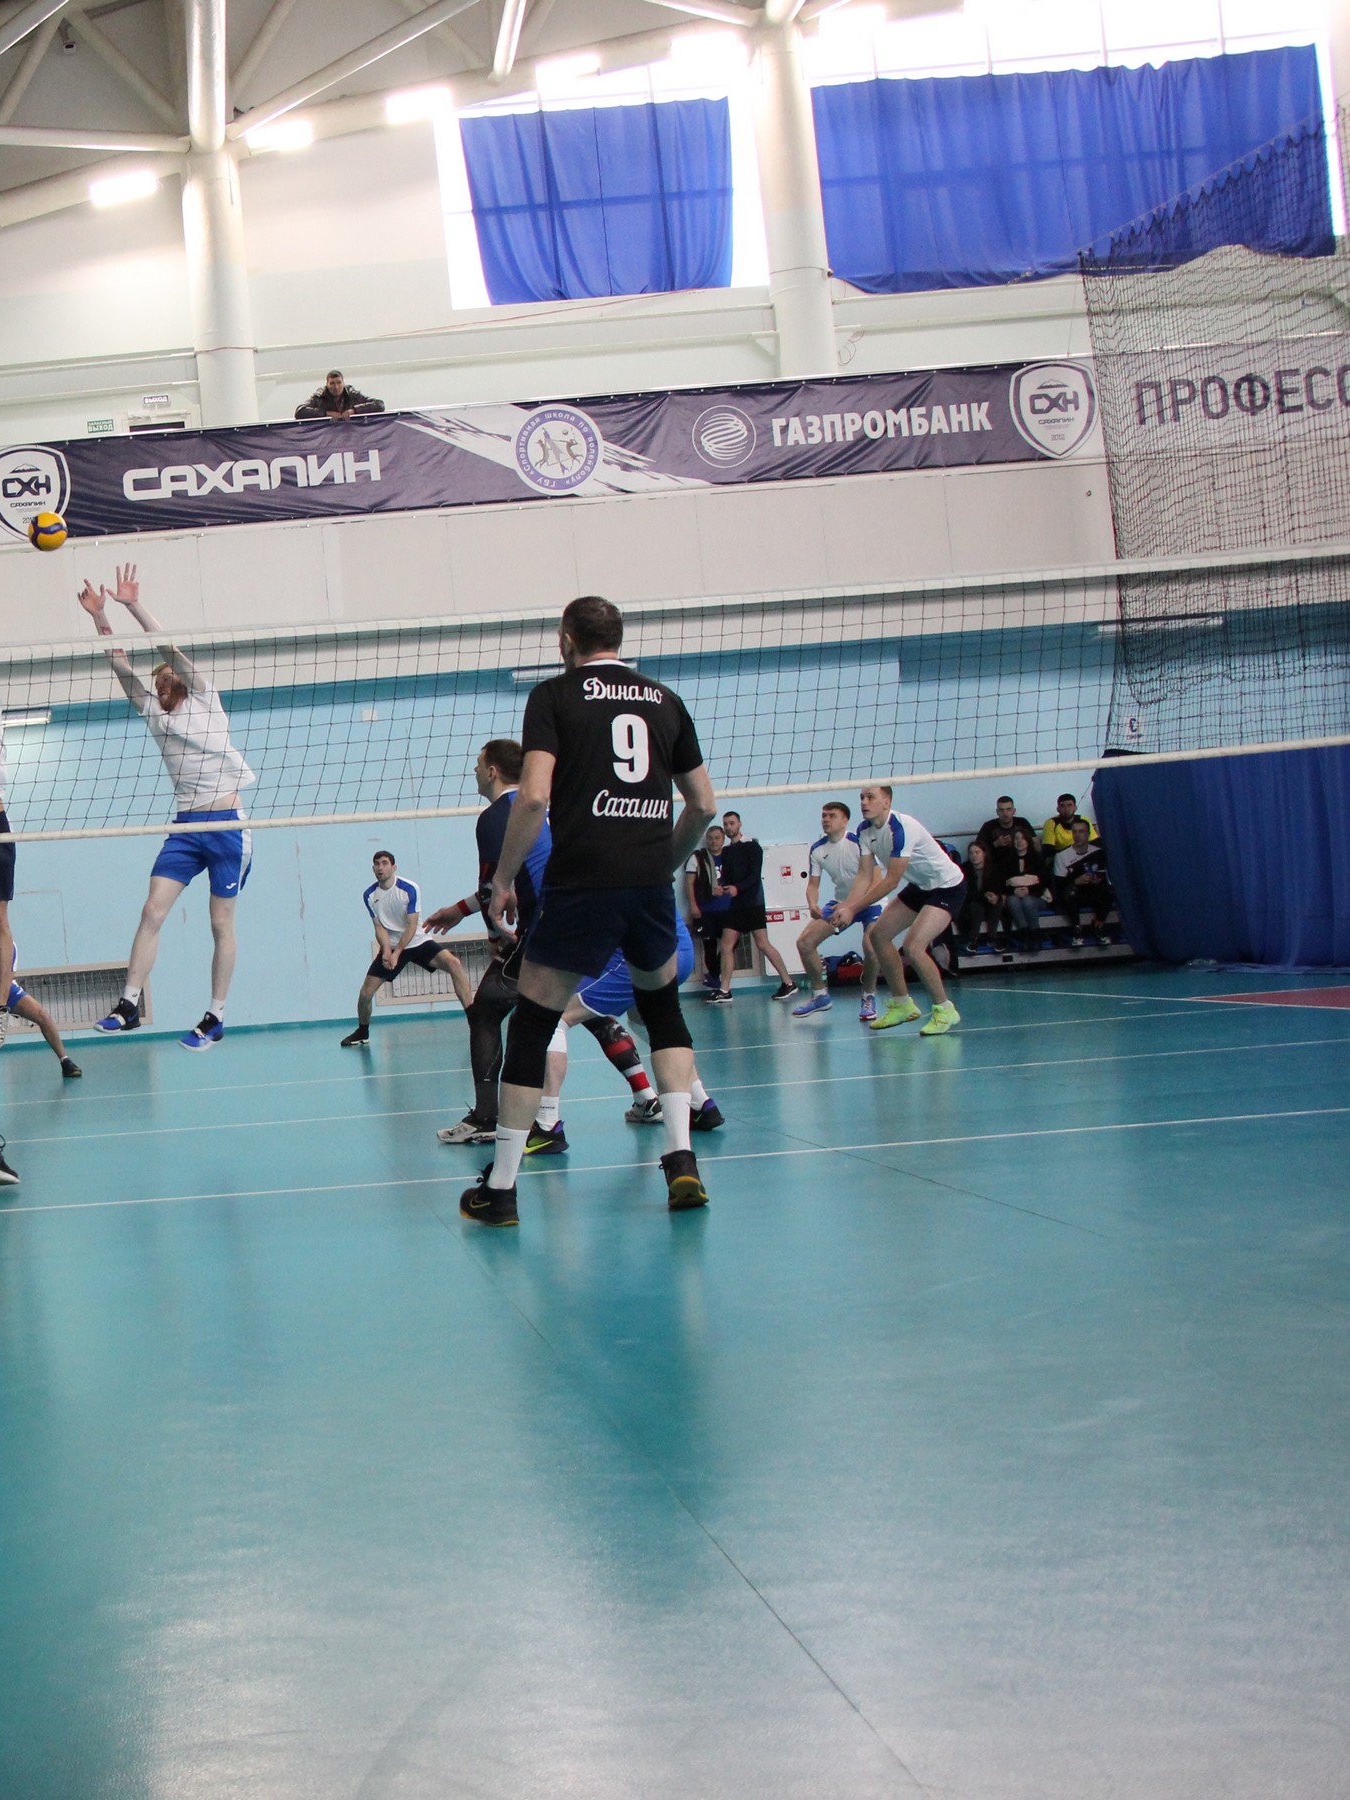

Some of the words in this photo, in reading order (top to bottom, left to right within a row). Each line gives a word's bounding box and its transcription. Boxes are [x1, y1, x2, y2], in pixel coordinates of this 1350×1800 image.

[88, 424, 113, 432] ВЫХОД
[771, 401, 993, 447] ГАЗПРОМБАНК
[122, 449, 381, 501] САХАЛИН
[536, 477, 556, 488] ГБУ
[582, 676, 663, 705] Динамо
[611, 713, 650, 784] 9
[591, 789, 669, 820] Сахалин
